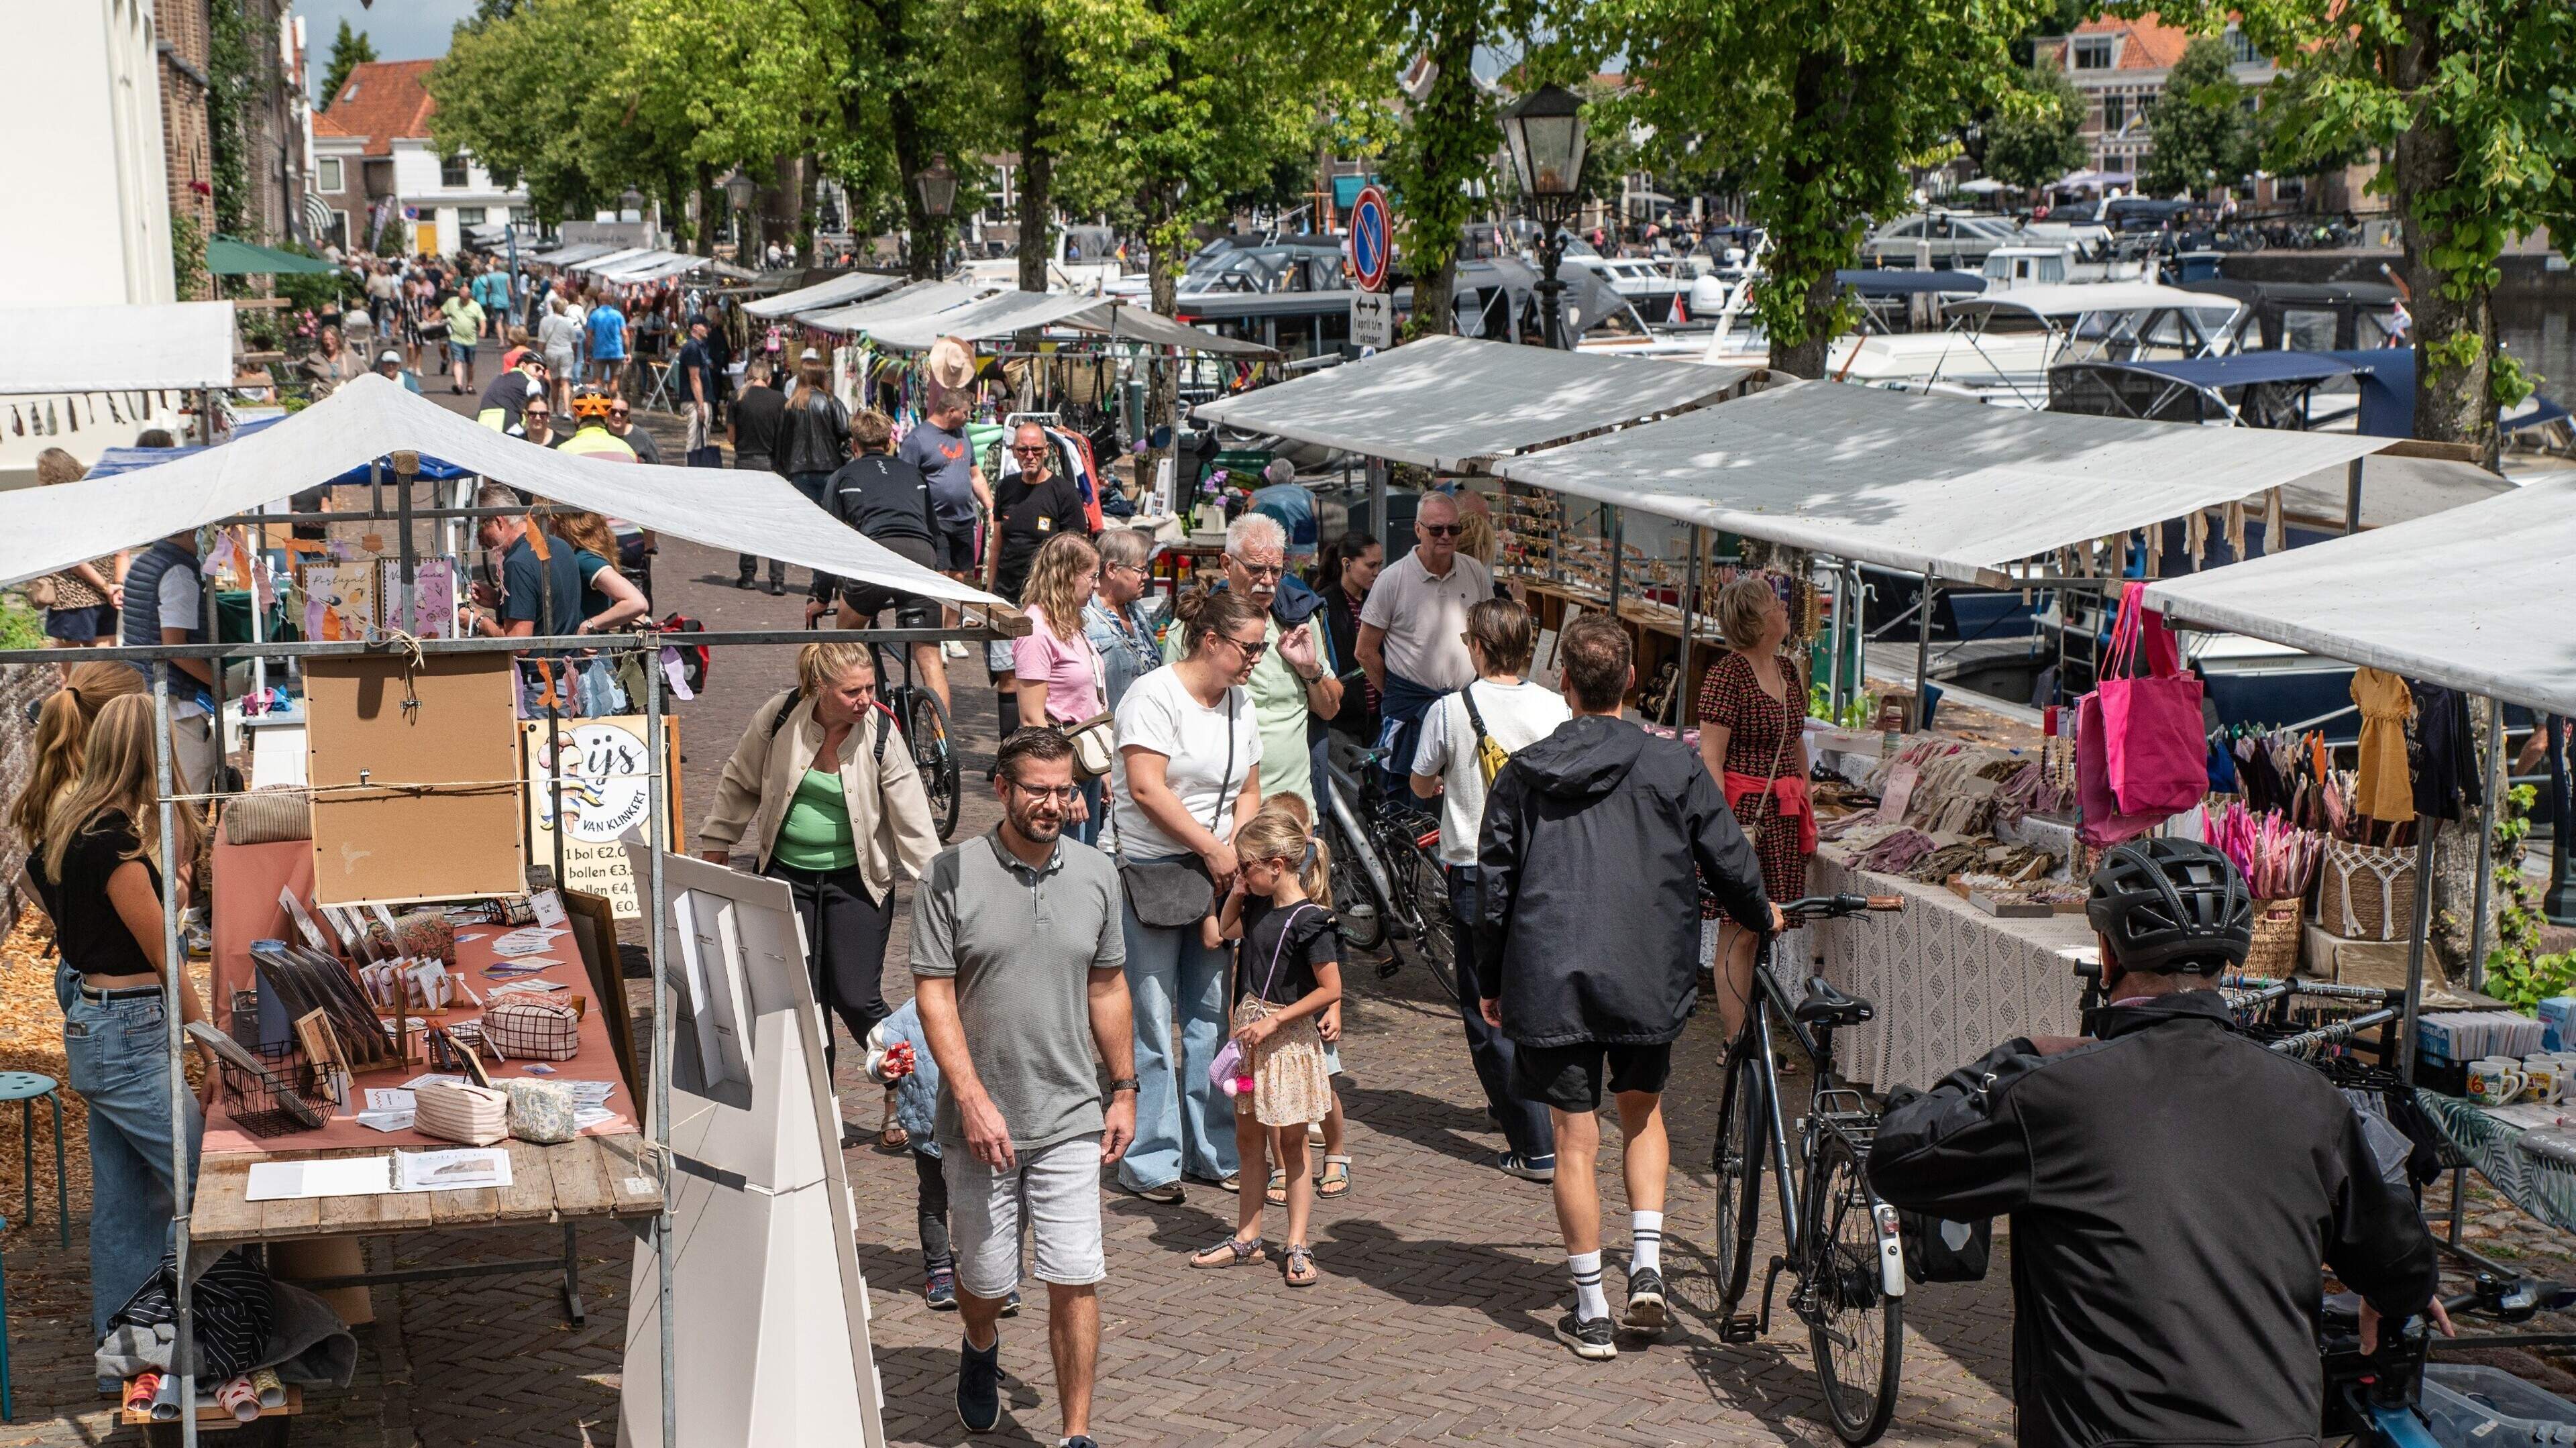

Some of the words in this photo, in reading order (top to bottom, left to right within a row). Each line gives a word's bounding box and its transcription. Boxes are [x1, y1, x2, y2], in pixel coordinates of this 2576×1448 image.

[1357, 318, 1371, 331] april
[1371, 318, 1383, 331] t/m
[1360, 333, 1381, 345] oktober
[312, 573, 366, 589] Portugal
[583, 819, 604, 832] VAN
[607, 789, 646, 830] KLINKERT
[566, 848, 571, 860] 1
[575, 848, 593, 860] bol
[569, 866, 606, 879] bollen
[615, 901, 640, 912] €0,
